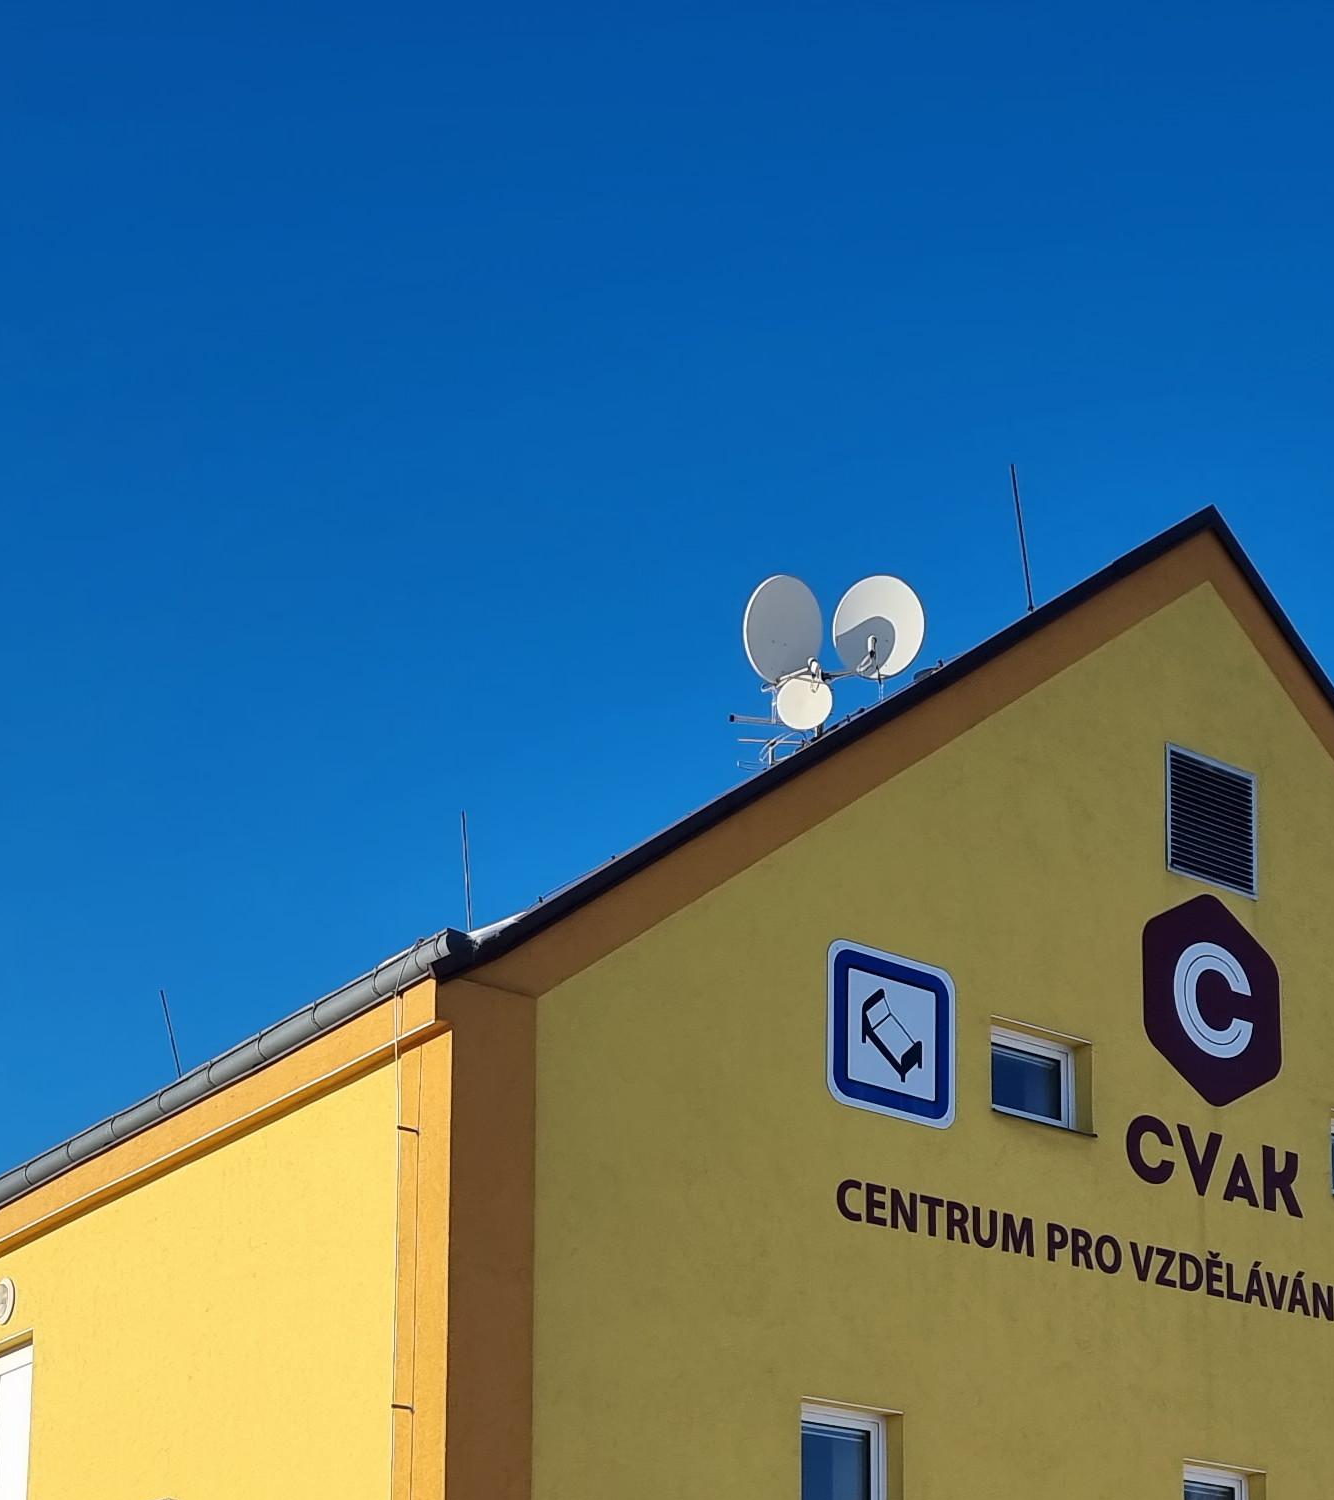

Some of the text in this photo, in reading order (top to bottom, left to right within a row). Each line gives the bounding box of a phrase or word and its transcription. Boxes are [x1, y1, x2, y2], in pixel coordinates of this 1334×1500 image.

[1173, 941, 1253, 1059] C
[835, 1178, 1035, 1258] CENTRUM
[1046, 1222, 1123, 1275] PRO
